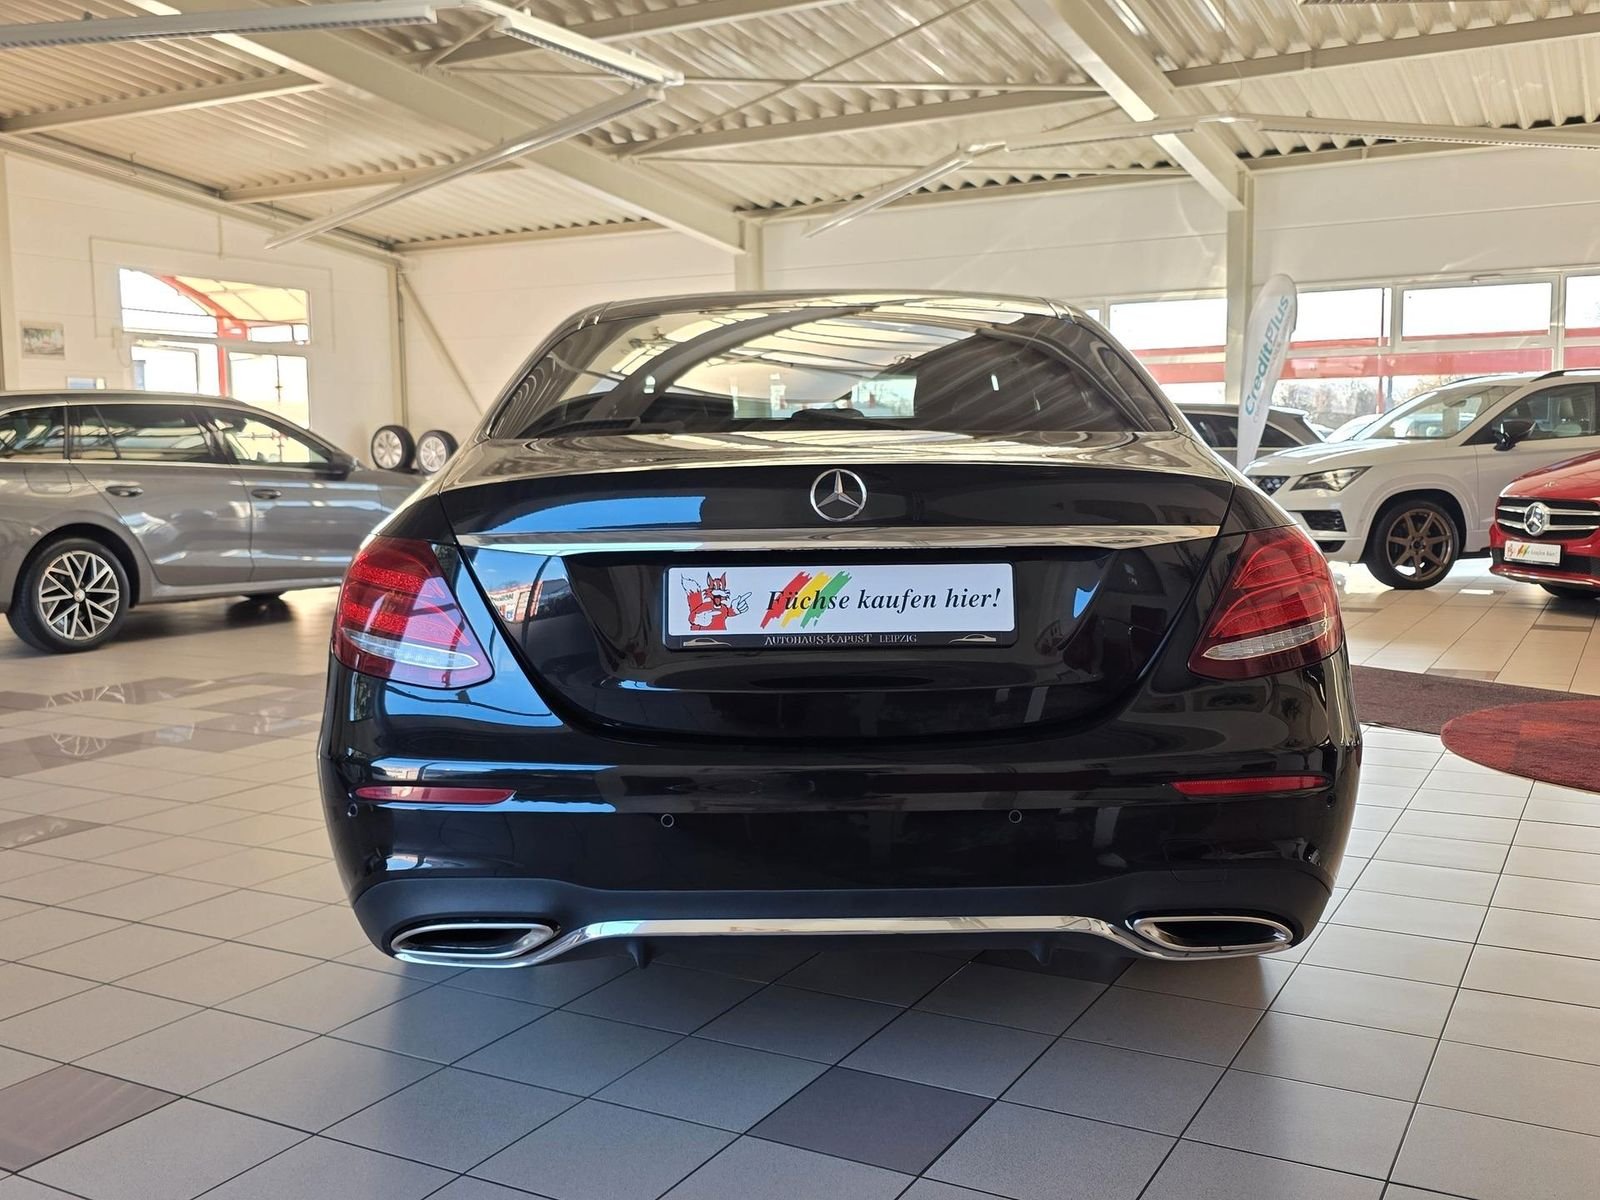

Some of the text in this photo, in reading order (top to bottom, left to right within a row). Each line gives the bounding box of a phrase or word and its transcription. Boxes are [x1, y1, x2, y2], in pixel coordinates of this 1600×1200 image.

[1244, 295, 1290, 416] CreditPlus
[766, 587, 1002, 614] Füchse kaufen hier!
[879, 634, 917, 644] LEIPZIG
